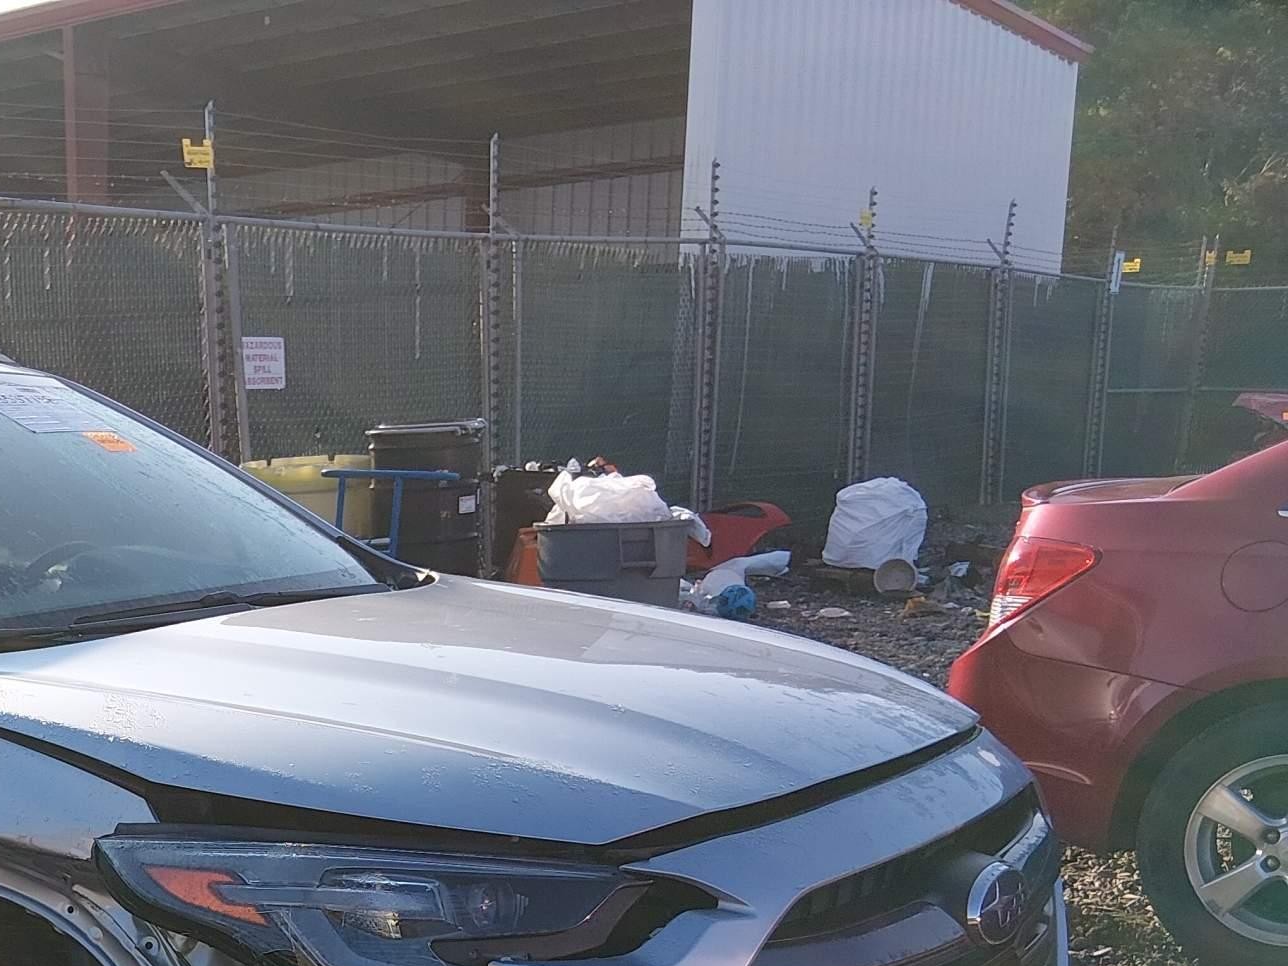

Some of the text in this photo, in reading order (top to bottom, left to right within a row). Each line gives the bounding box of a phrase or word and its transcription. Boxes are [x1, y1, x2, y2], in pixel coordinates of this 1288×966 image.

[243, 341, 282, 350] AZARDOUS
[245, 353, 279, 362] MATERIAL
[254, 365, 272, 374] SPILL
[245, 376, 283, 385] BSORBENT
